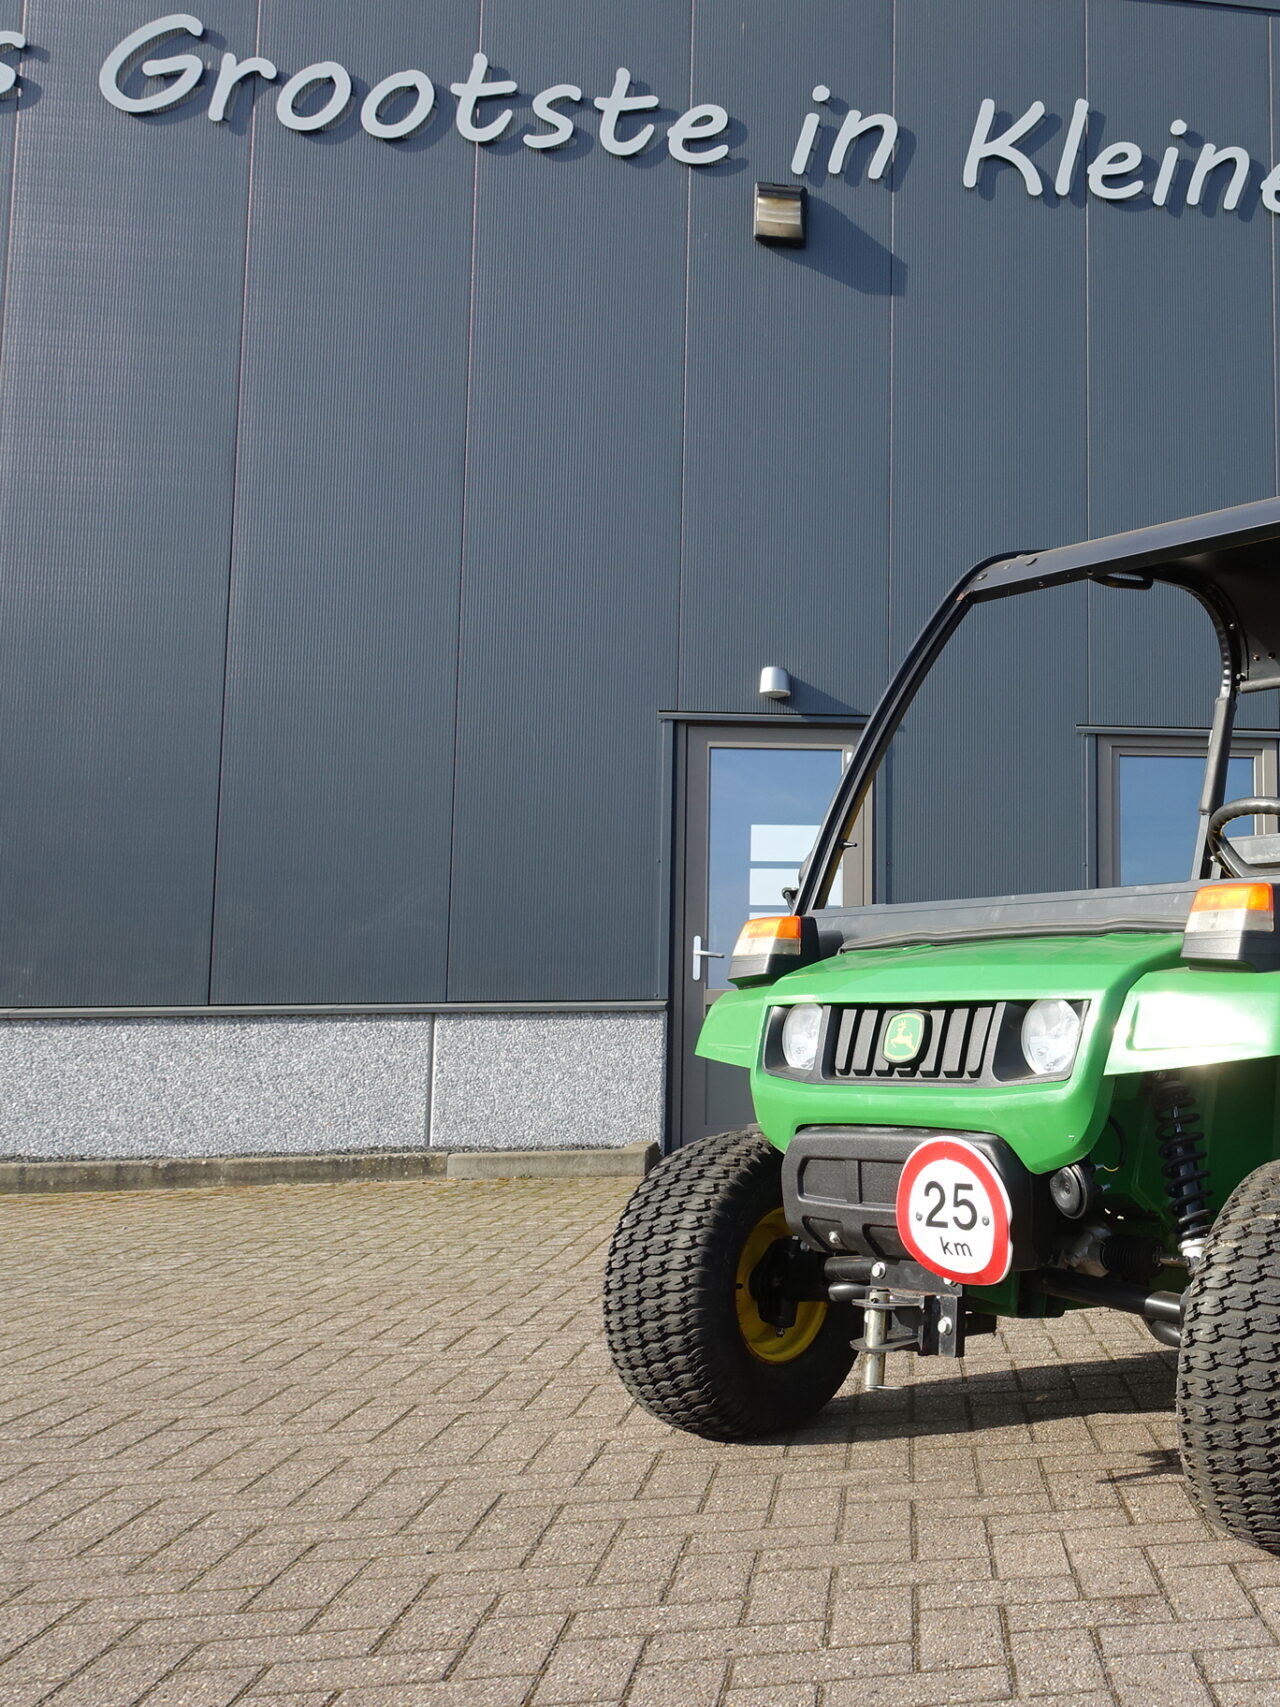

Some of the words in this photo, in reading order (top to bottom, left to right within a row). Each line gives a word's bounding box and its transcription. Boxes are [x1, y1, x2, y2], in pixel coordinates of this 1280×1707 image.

[99, 13, 729, 164] Grootste
[791, 84, 899, 180] in
[924, 1180, 978, 1231] 25
[939, 1235, 973, 1257] km
